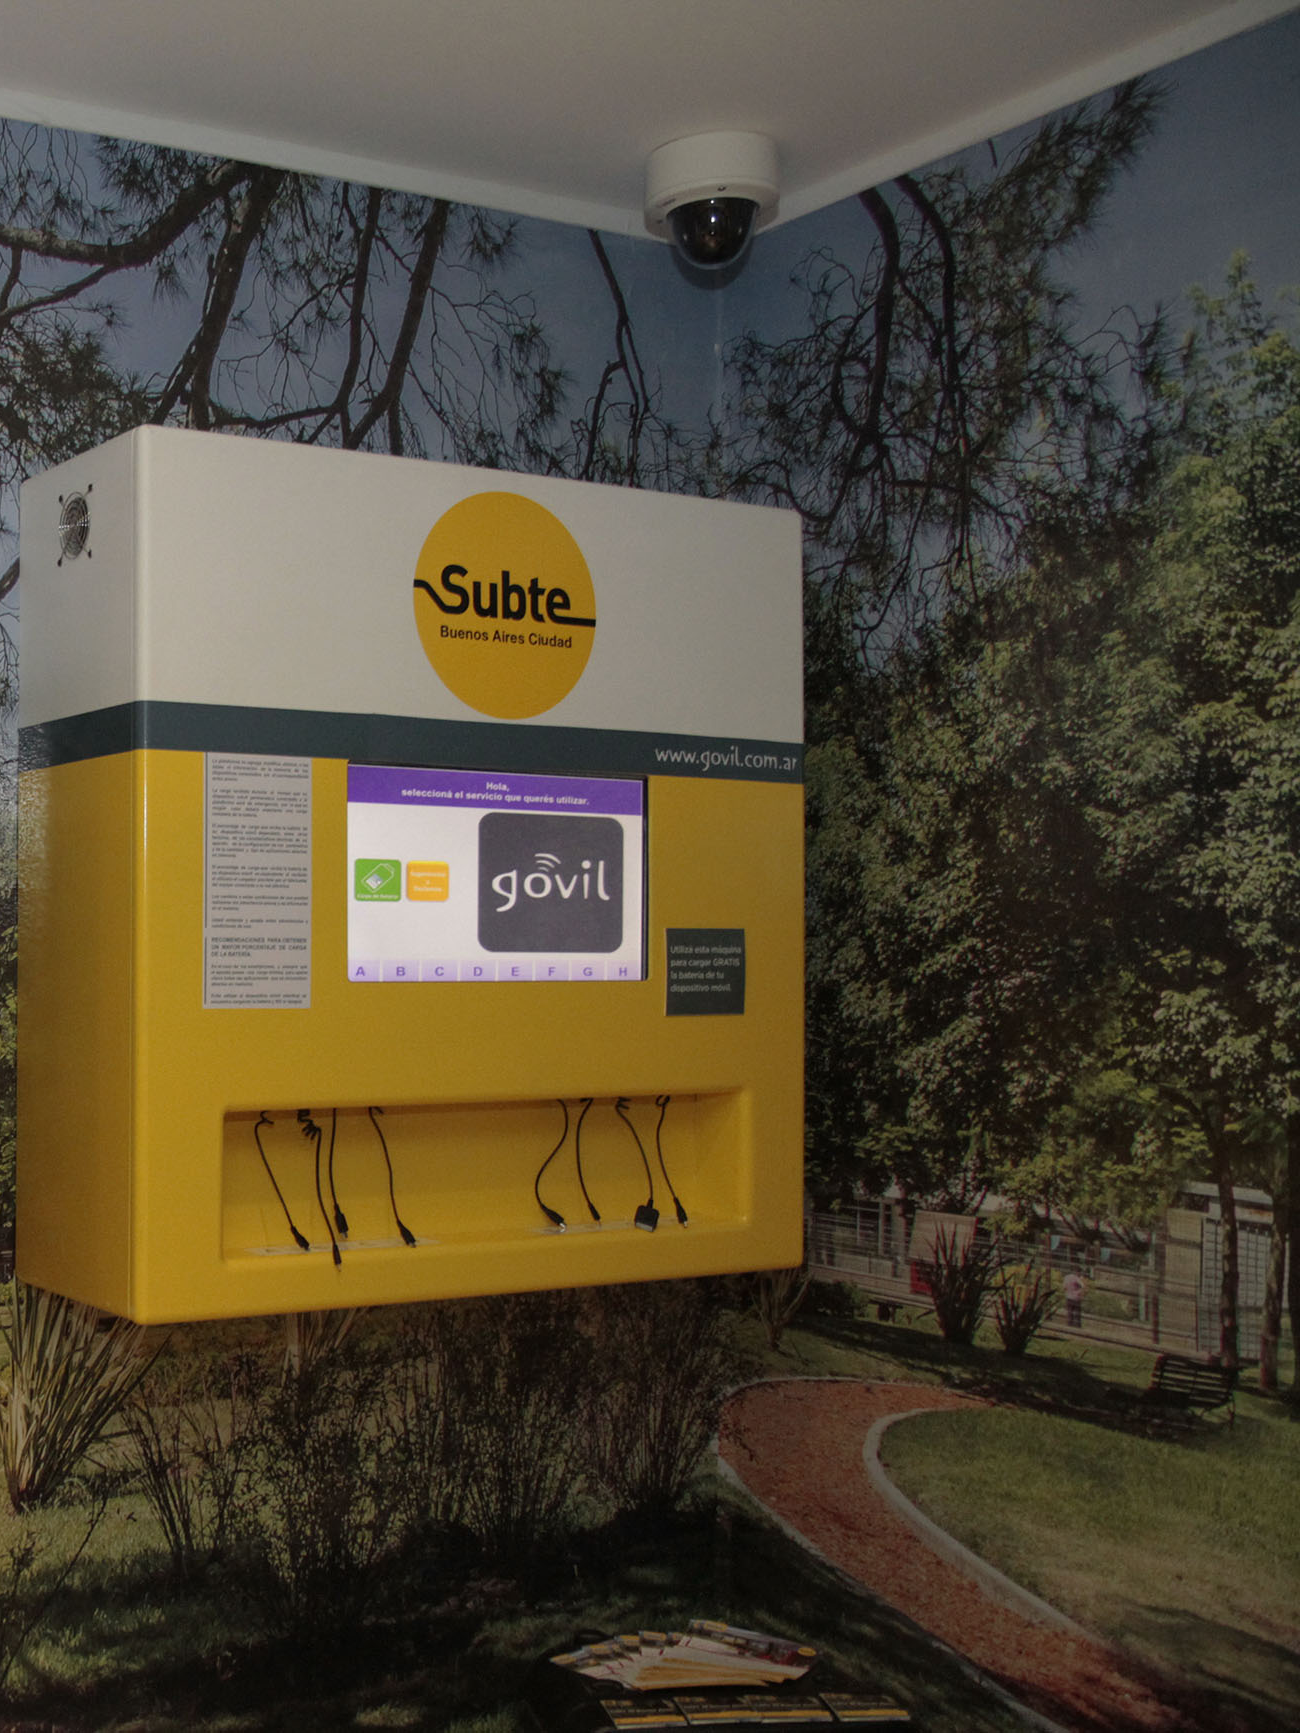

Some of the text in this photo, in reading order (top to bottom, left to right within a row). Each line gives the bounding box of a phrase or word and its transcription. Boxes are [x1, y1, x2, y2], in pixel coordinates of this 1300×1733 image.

[413, 564, 596, 628] Subte
[440, 625, 573, 648] Buenos Aires Ciudad
[655, 745, 797, 771] www.govil.com.ar
[486, 781, 510, 793] Hola,
[454, 790, 464, 799] el
[466, 791, 503, 801] servicio
[504, 794, 521, 804] que
[523, 794, 554, 804] querés
[492, 860, 610, 913] govil
[712, 957, 741, 967] GRATIS
[355, 967, 628, 977] A B C D E F G H
